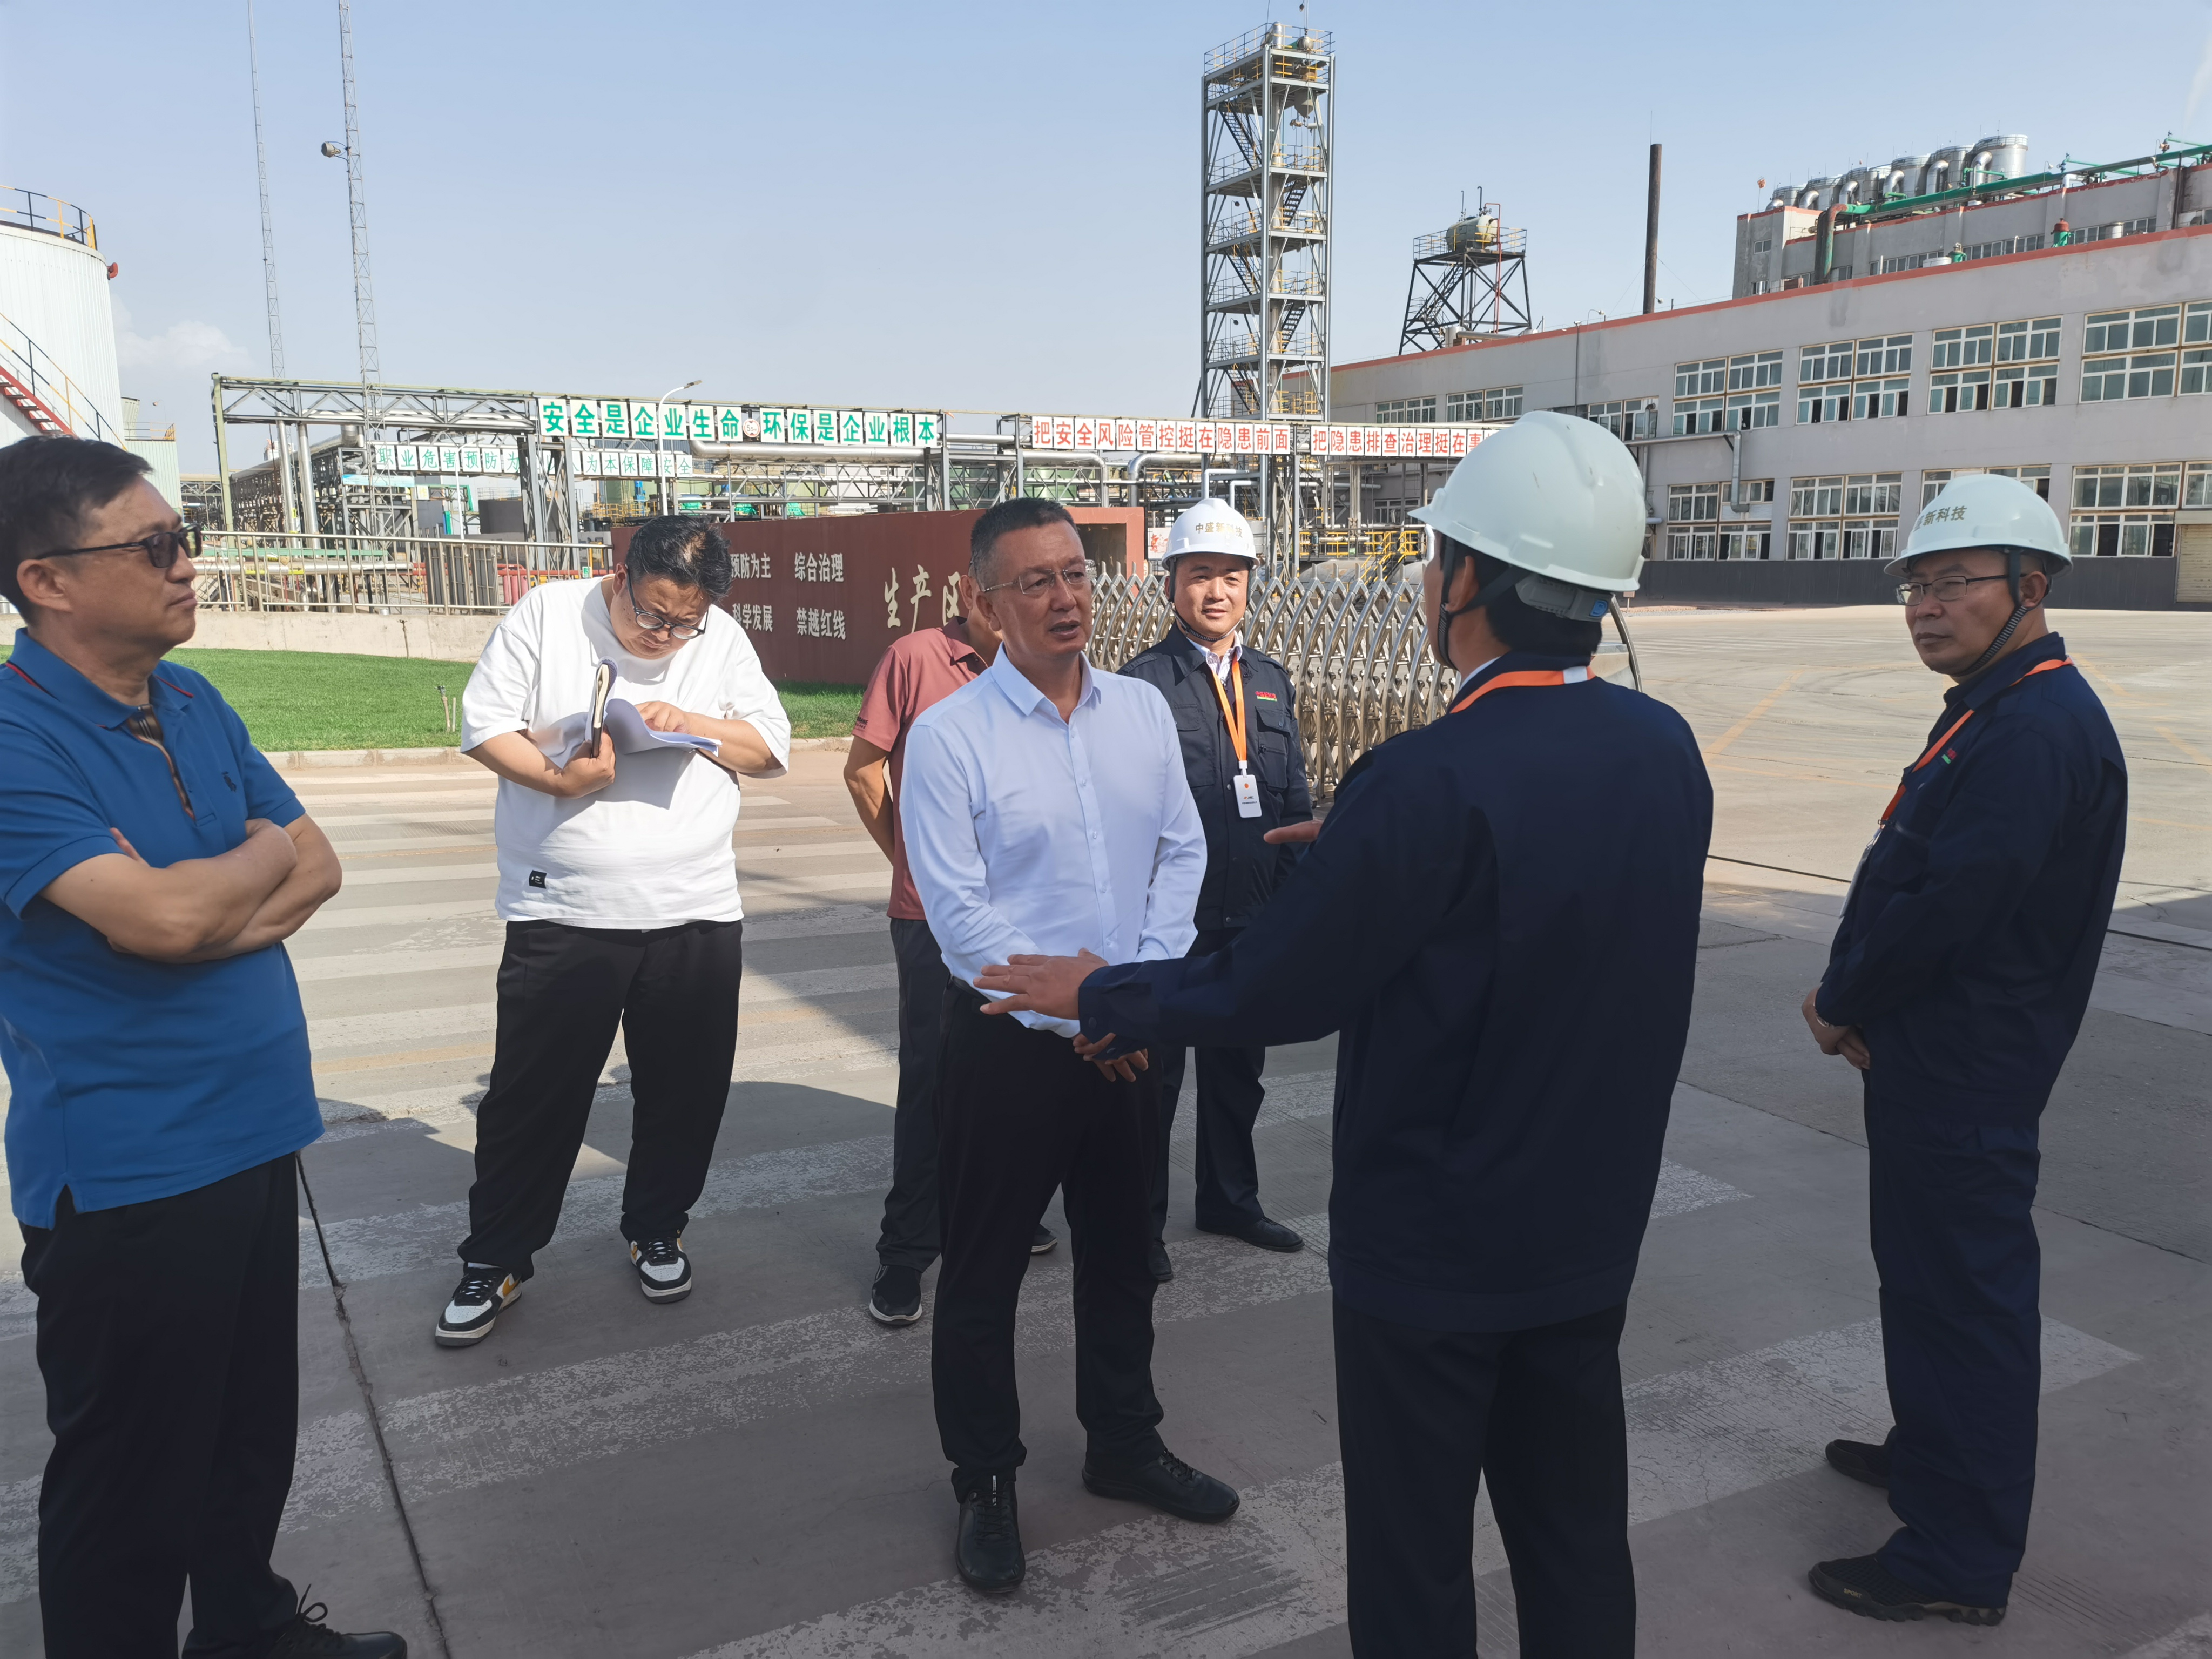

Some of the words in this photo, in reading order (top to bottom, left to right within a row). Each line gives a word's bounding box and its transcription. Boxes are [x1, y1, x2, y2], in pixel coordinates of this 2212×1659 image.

[543, 402, 740, 438] 安全是企业生命
[763, 412, 935, 444] 环保是企业根本
[1034, 417, 1289, 451] 把安全风险管控挺在隐患前面
[1313, 430, 1491, 454] 把隐患排查治理挺在事
[730, 552, 771, 579] 预防为主
[794, 552, 844, 582] 综合治理
[732, 603, 773, 632] 科学发展
[797, 606, 846, 640] 禁越红线
